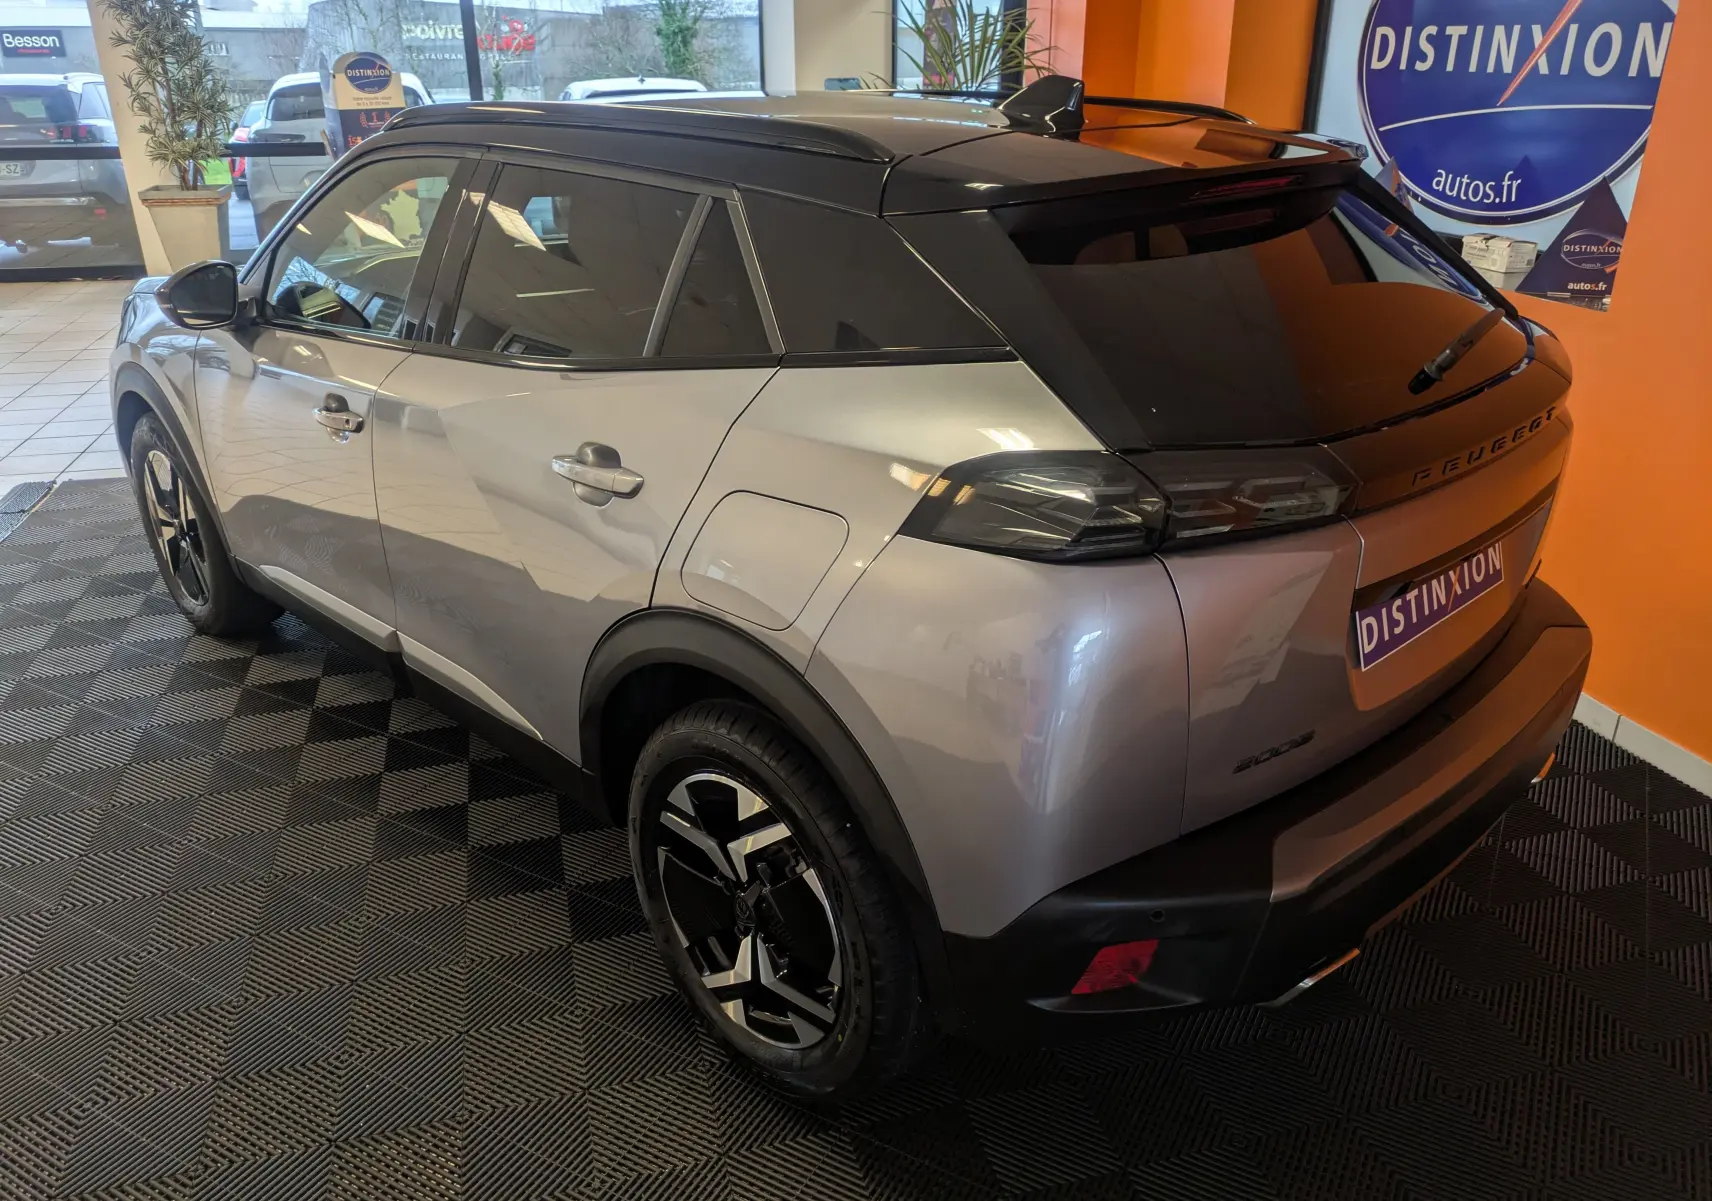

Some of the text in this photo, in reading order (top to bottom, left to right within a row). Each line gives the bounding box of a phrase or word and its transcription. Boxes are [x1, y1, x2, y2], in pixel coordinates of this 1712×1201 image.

[2, 33, 60, 47] Besson
[1371, 22, 1673, 77] DISTINXION
[347, 69, 390, 77] DISTINXION
[1432, 168, 1522, 204] autos.fr
[1567, 281, 1607, 291] autos.fr
[1412, 405, 1556, 487] PEUGEOT
[1361, 542, 1502, 654] DISTINXION
